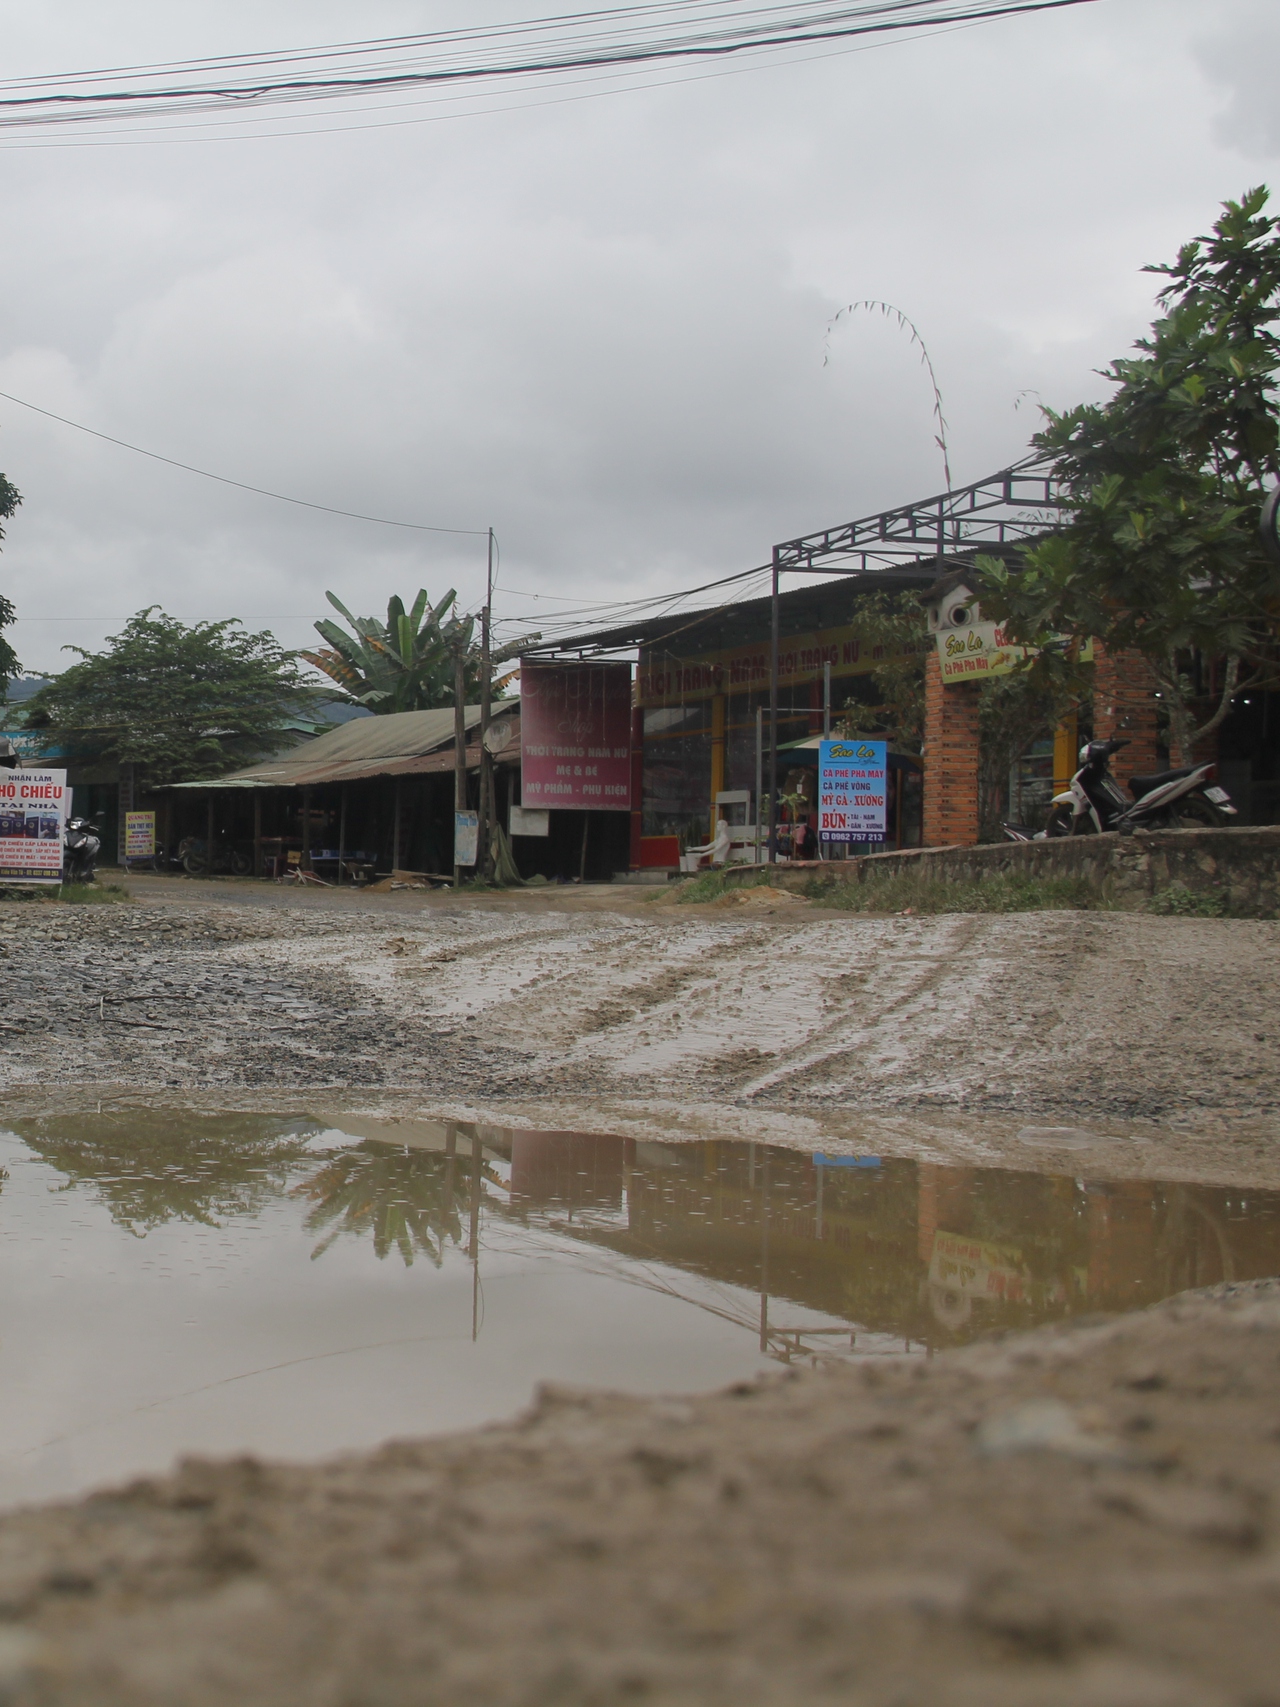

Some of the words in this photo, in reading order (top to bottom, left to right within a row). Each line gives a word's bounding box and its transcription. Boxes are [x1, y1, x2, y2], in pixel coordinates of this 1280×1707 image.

[945, 633, 966, 658] Sao
[967, 630, 984, 652] La
[552, 744, 586, 758] TRANG
[588, 747, 611, 759] NAM
[829, 744, 854, 759] Sao
[856, 744, 876, 759] La
[556, 764, 571, 778] MẸ
[573, 765, 582, 776] &
[851, 769, 866, 778] PHA
[20, 781, 63, 800] CHIẾU
[582, 784, 602, 797] PHỤ
[823, 780, 833, 790] CÀ
[0, 802, 24, 810] TẠI
[28, 802, 59, 810] NHÀ
[836, 792, 848, 806] GÀ
[821, 808, 847, 829] BÚN
[831, 833, 851, 841] 0962
[852, 833, 866, 841] 757
[868, 833, 883, 842] 213
